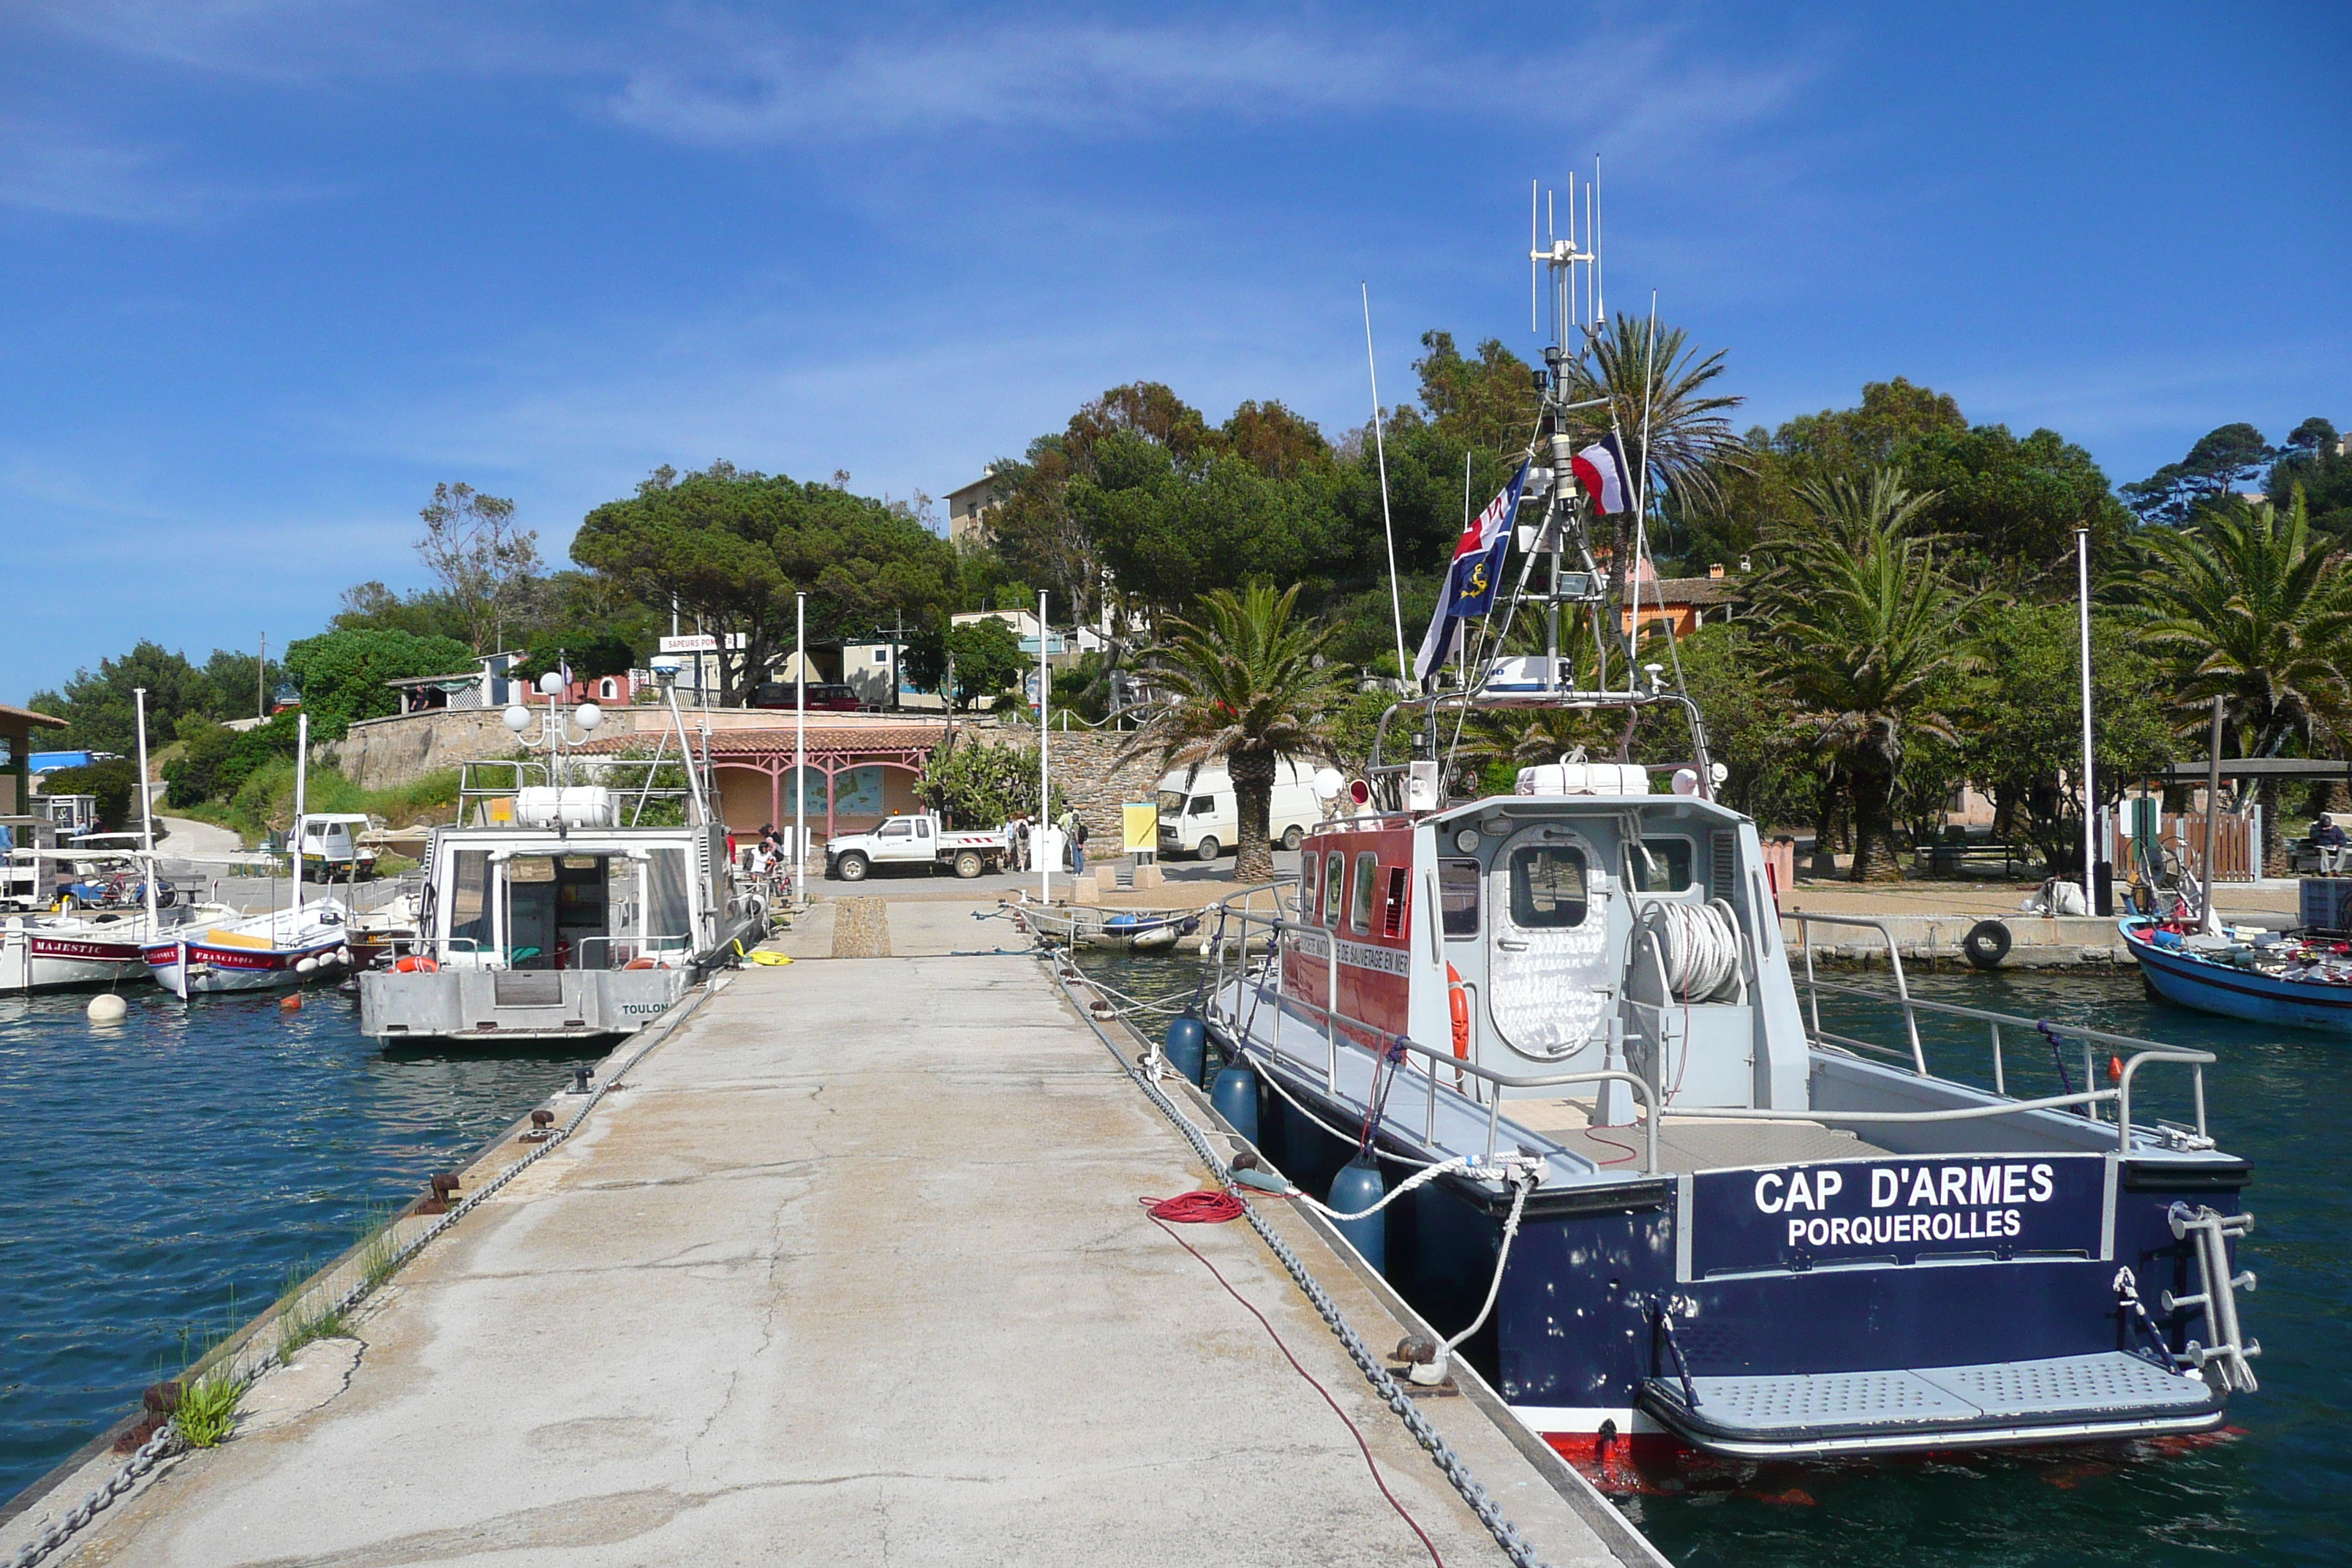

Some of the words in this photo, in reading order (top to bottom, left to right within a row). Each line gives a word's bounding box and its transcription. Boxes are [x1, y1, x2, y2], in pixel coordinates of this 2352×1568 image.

[668, 639, 699, 648] SAPEURS
[702, 638, 734, 647] POMR
[37, 941, 102, 954] MAJESTIC
[196, 951, 254, 964] FRANCISQUE
[1341, 944, 1349, 962] DE
[1350, 947, 1382, 969] SAUVETAGE
[1384, 952, 1393, 972] EN
[1395, 954, 1409, 974] MER
[622, 1004, 668, 1014] TOULON
[1755, 1170, 1842, 1214] CAP
[1872, 1164, 2054, 1207] D'ARMES
[1788, 1209, 2021, 1246] PORQUEROLLES
